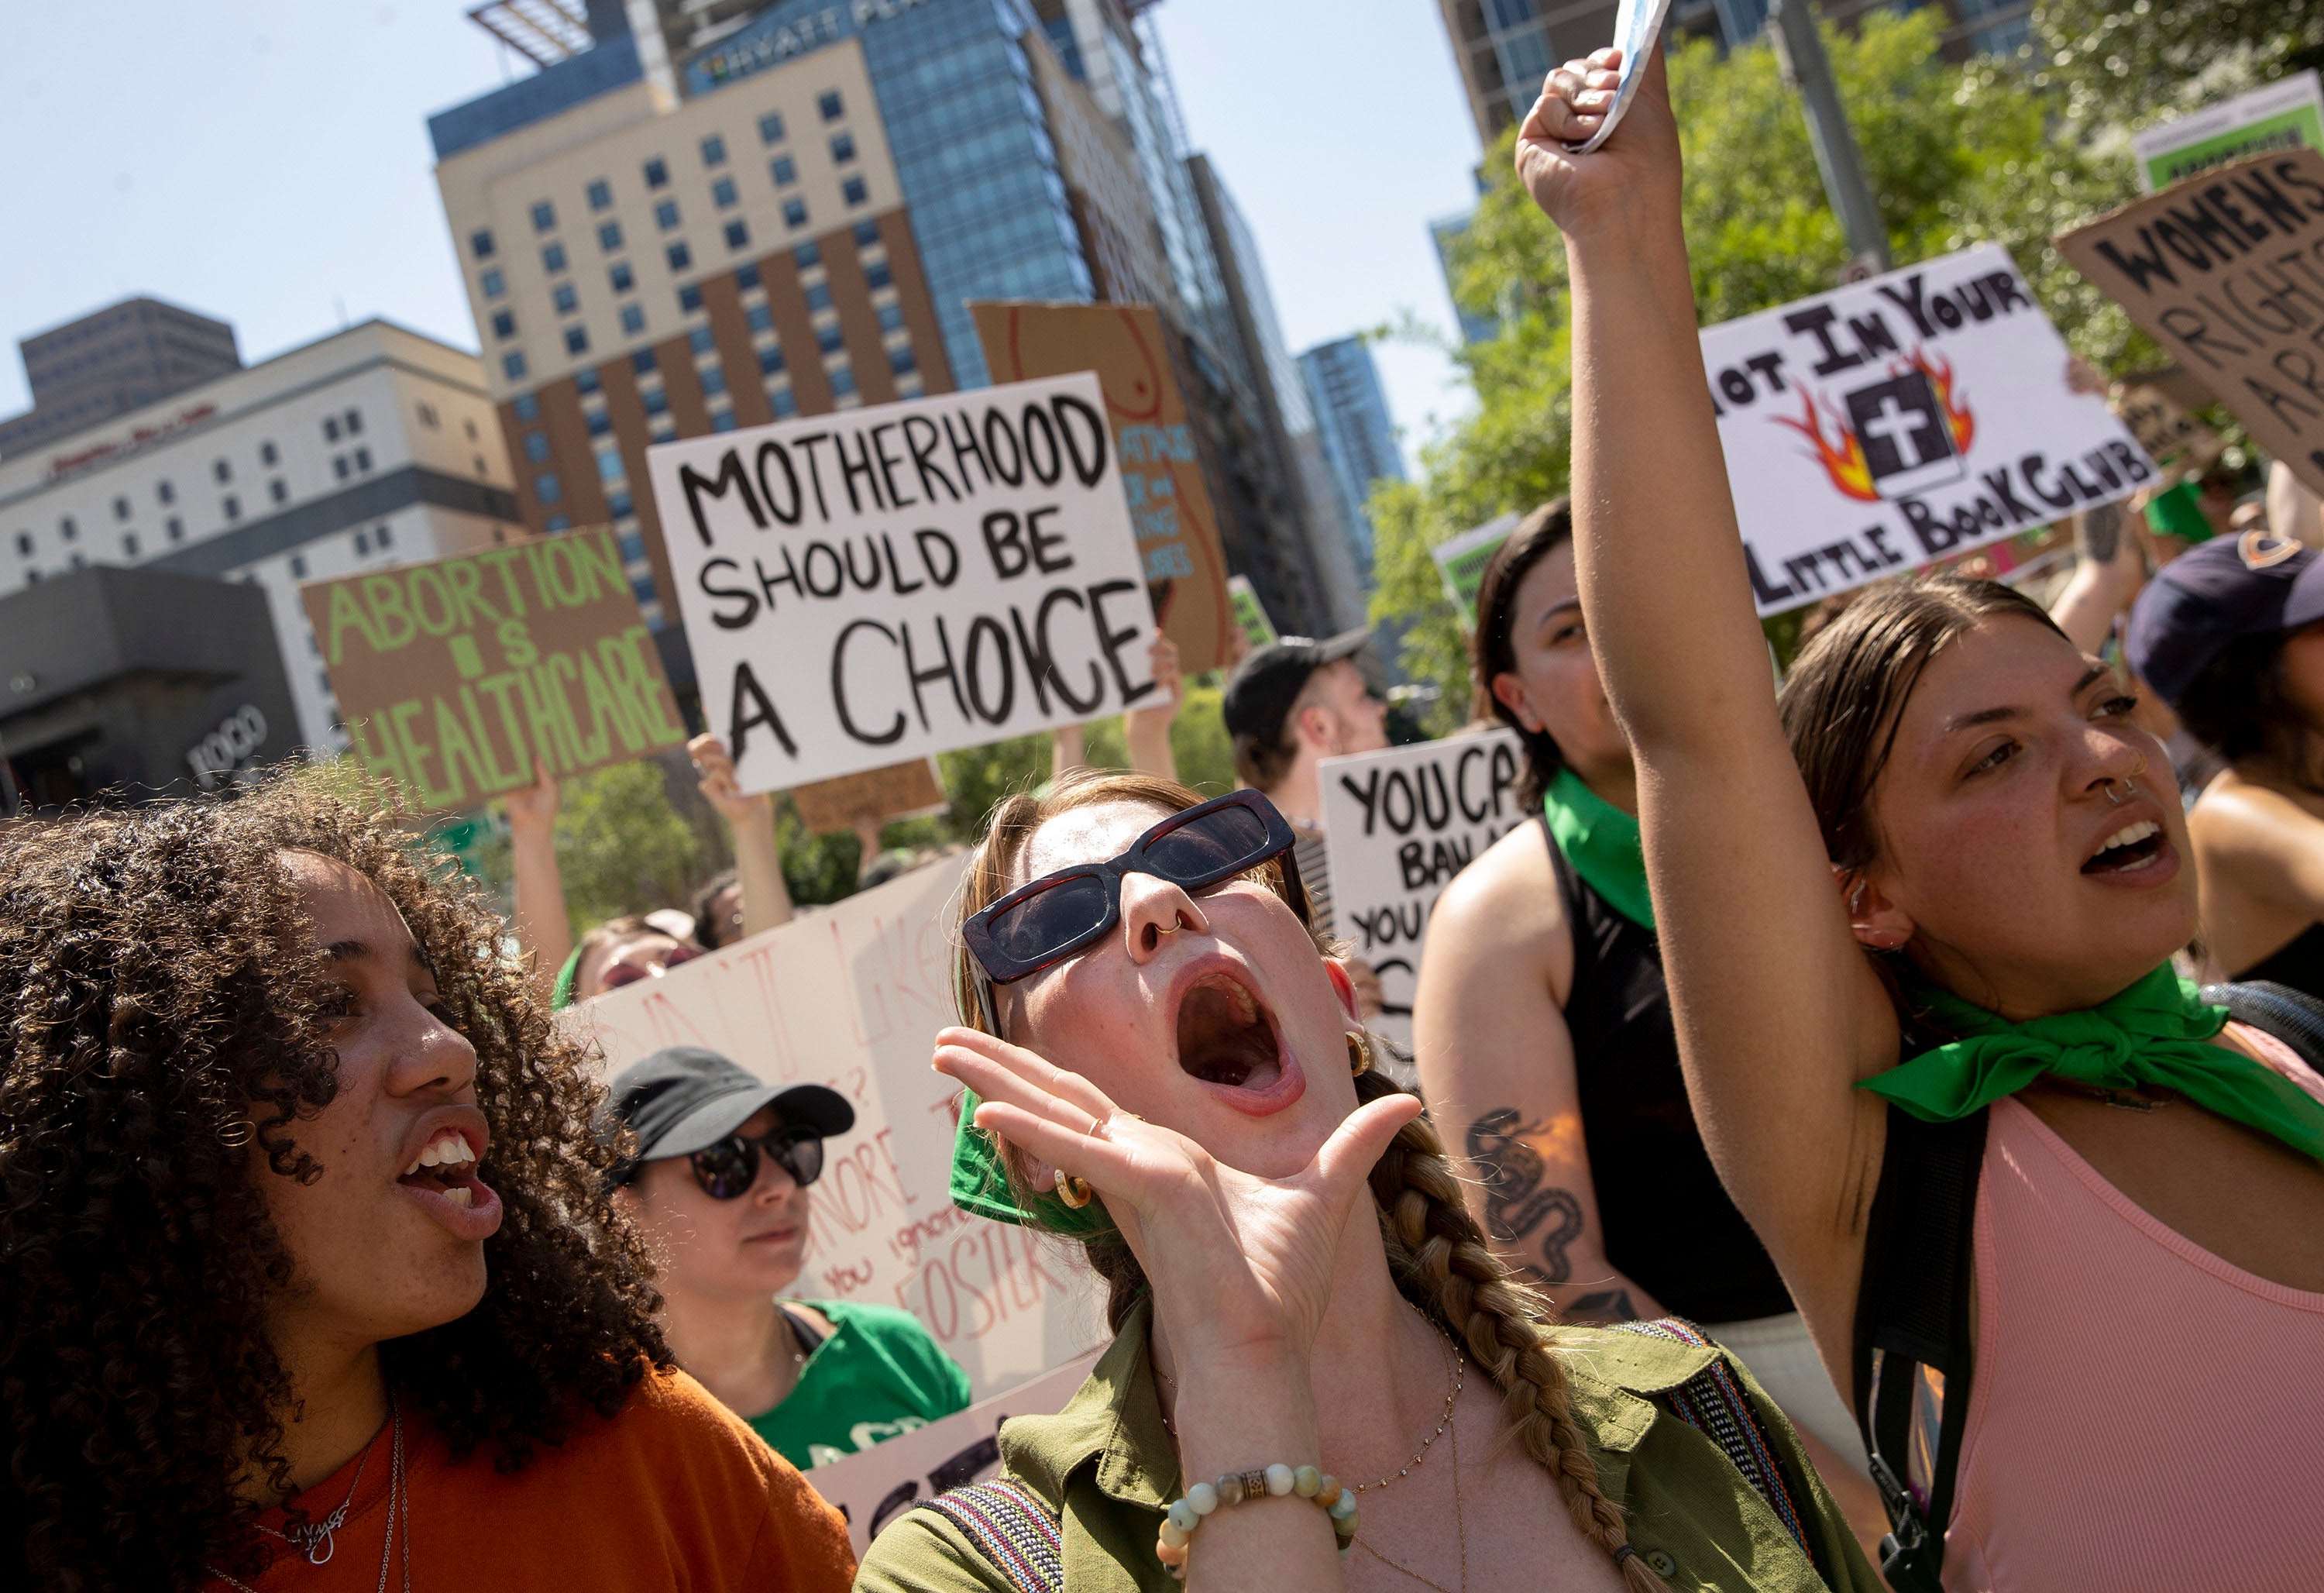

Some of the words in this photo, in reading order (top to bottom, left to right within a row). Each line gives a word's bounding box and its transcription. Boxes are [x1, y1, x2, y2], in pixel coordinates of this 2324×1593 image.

[725, 6, 841, 76] HYATT
[1714, 352, 1786, 417] OT
[1783, 303, 1899, 377] IN
[2243, 324, 2324, 435] AR
[679, 394, 1106, 547] MOTHERHOOD
[329, 530, 632, 667] ABORTION
[699, 528, 961, 628] SHOULD
[981, 504, 1076, 580] BE
[1743, 525, 1903, 605] LITTLE
[349, 624, 686, 812] HEALTHCARE
[729, 661, 798, 767] A
[831, 579, 1156, 747] CHOICE
[1341, 761, 1449, 835] YOU
[1456, 741, 1517, 824] CA
[1349, 897, 1422, 951] YOU
